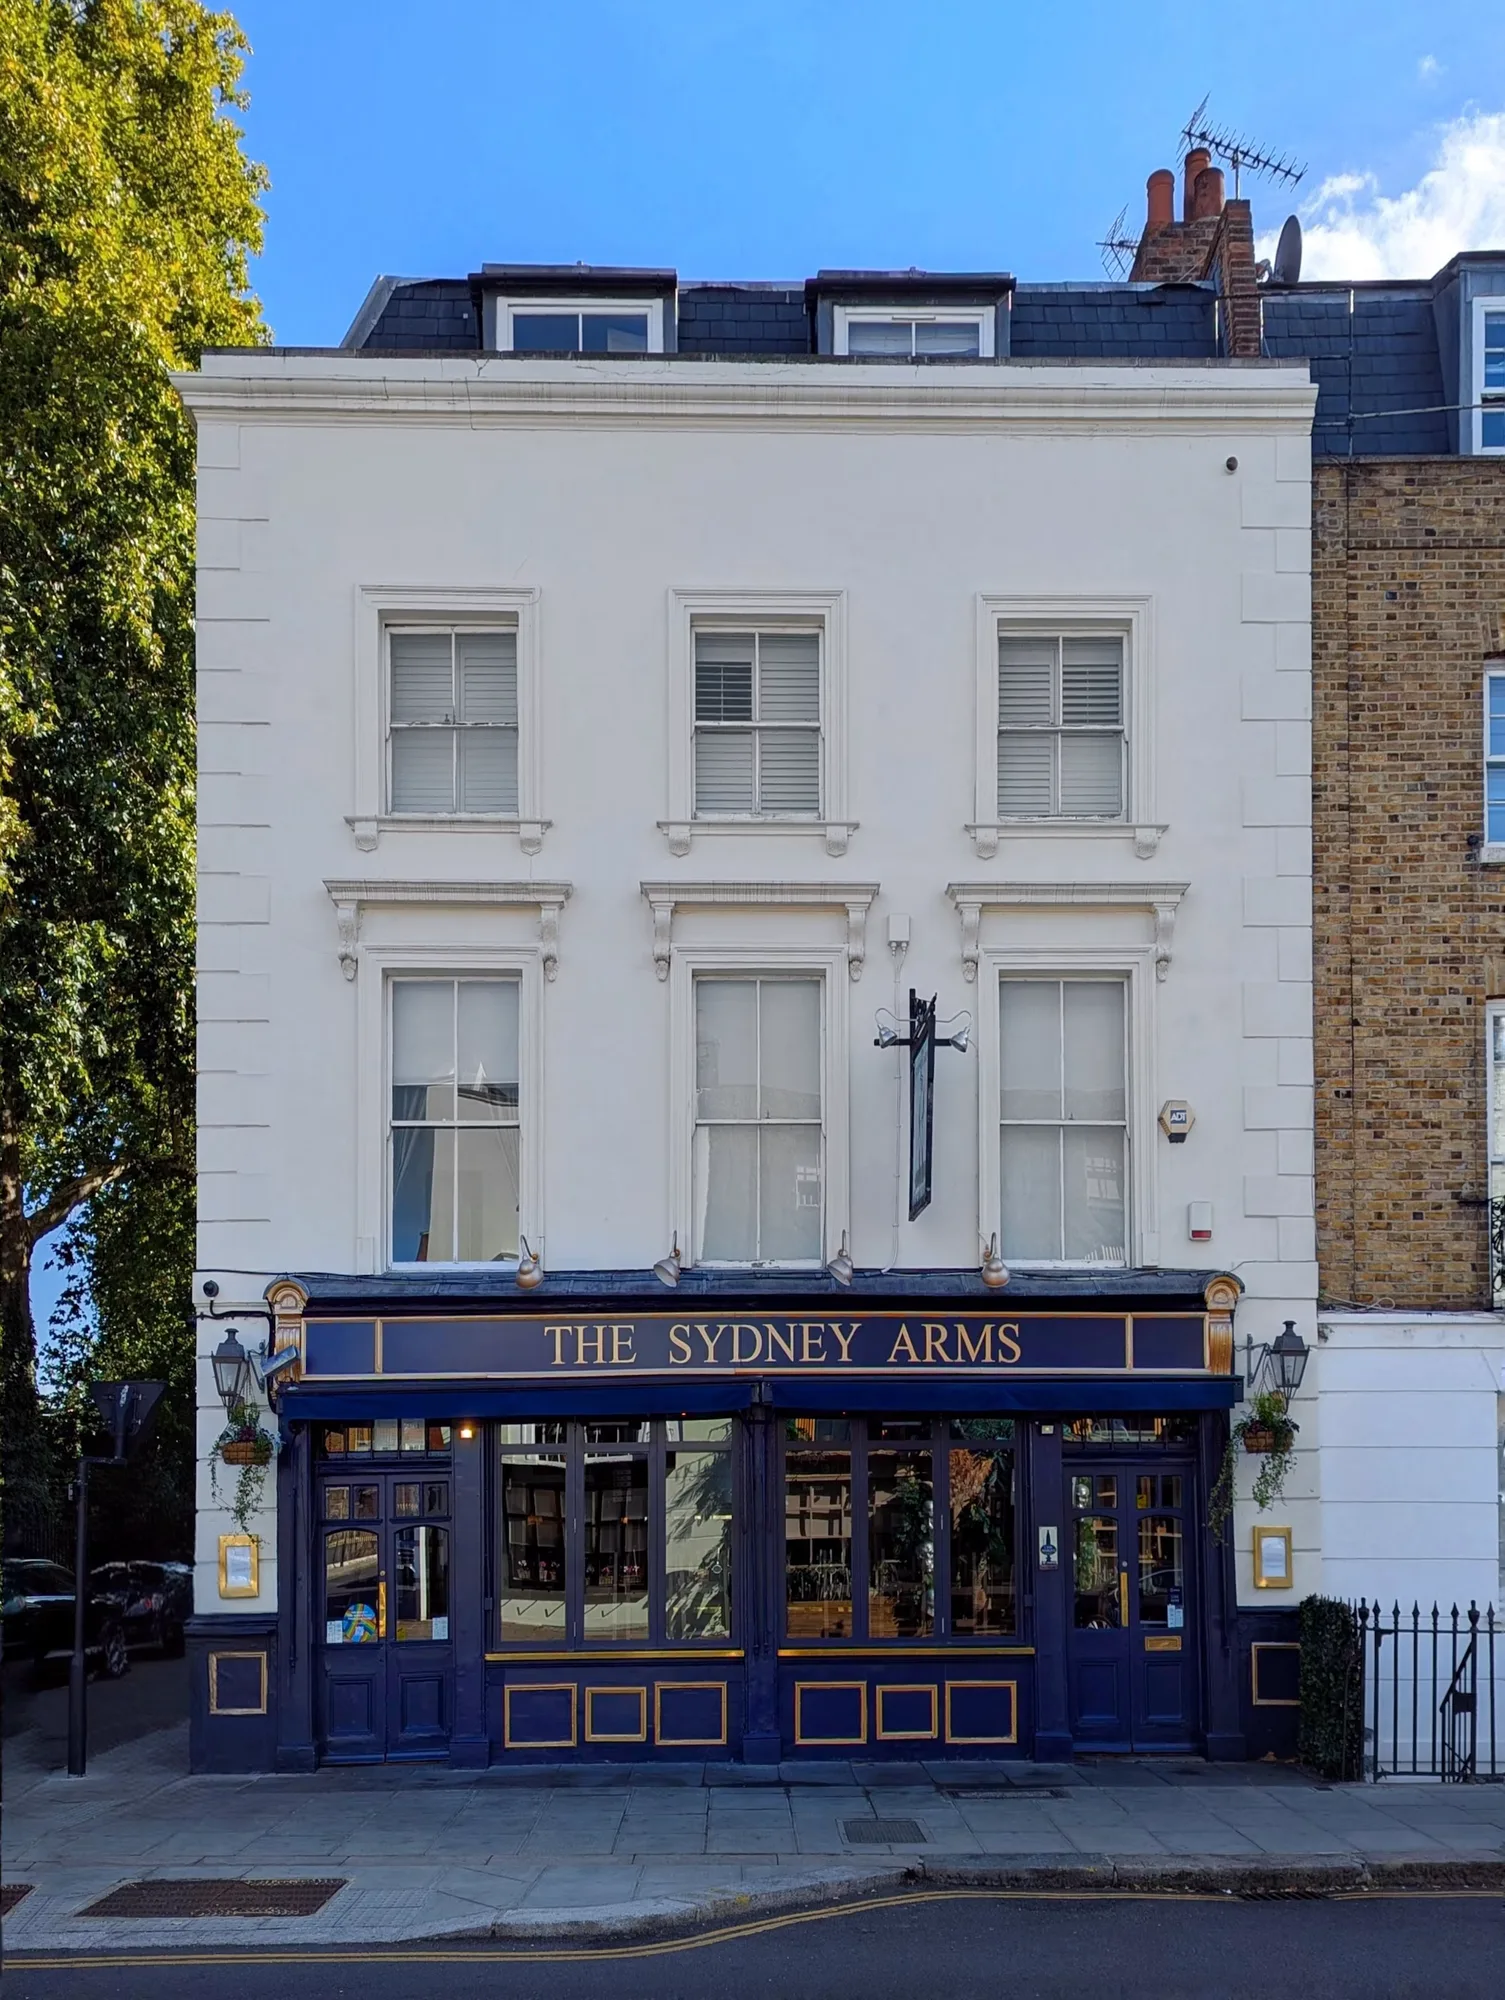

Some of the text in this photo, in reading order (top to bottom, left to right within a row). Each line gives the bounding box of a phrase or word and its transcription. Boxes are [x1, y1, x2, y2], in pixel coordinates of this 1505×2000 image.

[1171, 1112, 1187, 1121] ADT
[543, 1323, 1022, 1365] THE SYDNEY ARMS
